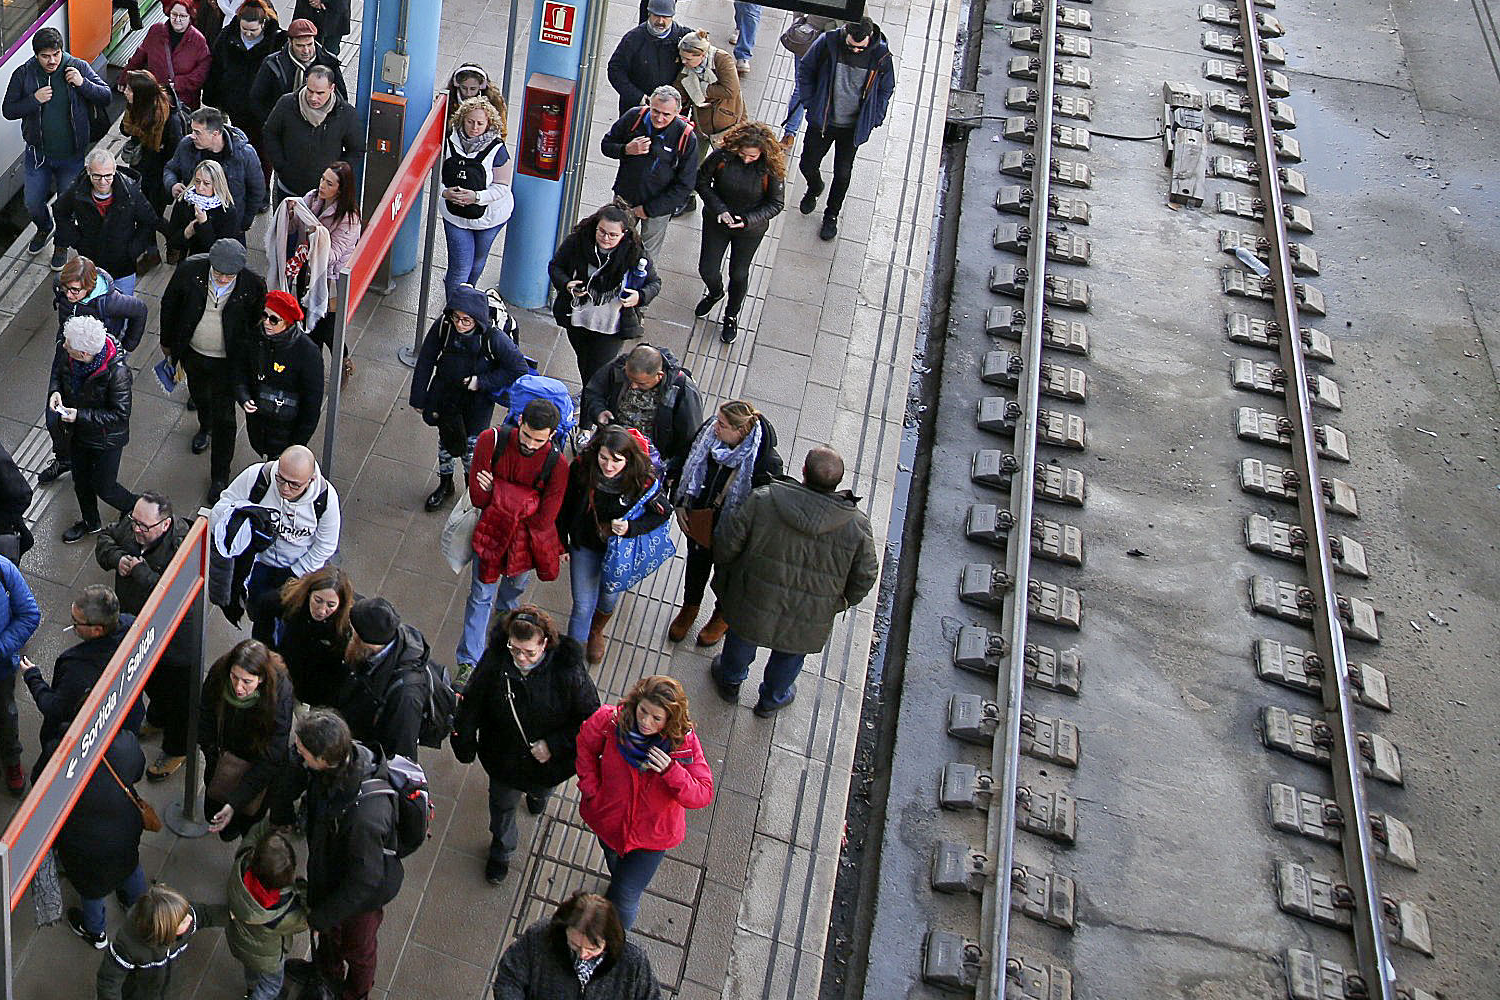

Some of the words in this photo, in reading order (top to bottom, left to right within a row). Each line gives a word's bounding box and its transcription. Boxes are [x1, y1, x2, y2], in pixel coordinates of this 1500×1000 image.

[543, 32, 570, 42] EXTINTOR
[81, 691, 117, 759] Sortida
[127, 626, 155, 682] Salida
